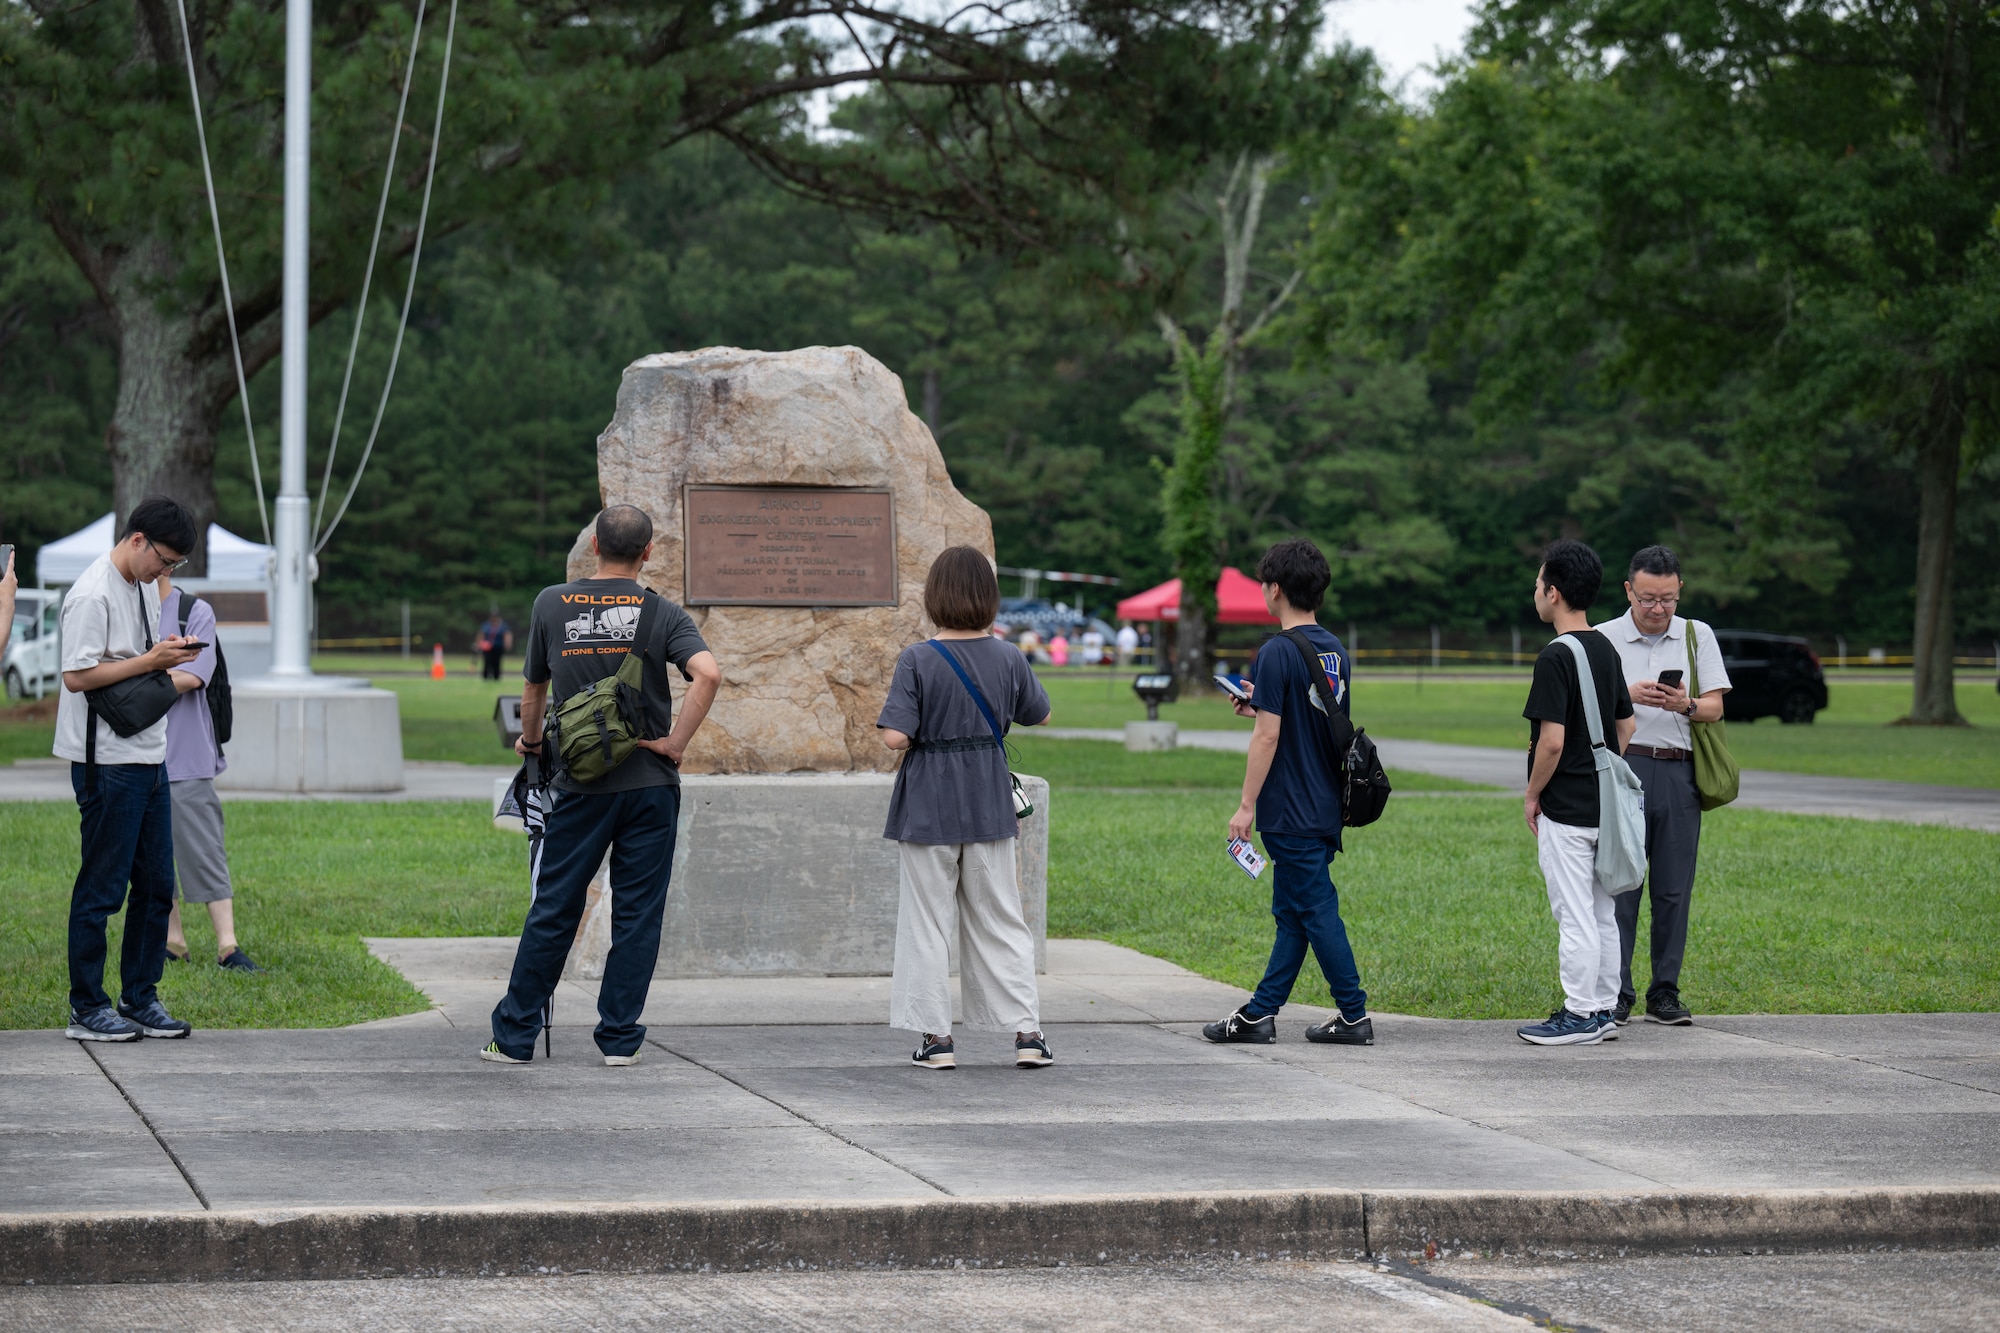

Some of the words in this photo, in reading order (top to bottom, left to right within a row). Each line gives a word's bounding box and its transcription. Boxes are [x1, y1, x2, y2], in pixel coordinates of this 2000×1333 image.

[758, 499, 822, 511] ARNOLD
[698, 514, 780, 526] ENGINEERING
[789, 516, 882, 527] DEVELOPMENT
[766, 531, 817, 542] CENTER
[759, 545, 805, 553] DEDICATED
[743, 556, 779, 566] HARRY
[796, 557, 839, 566] TRUMAN
[766, 568, 778, 576] OF
[782, 568, 798, 576] THE
[561, 594, 644, 605] VOLCOM
[561, 648, 594, 657] STONE
